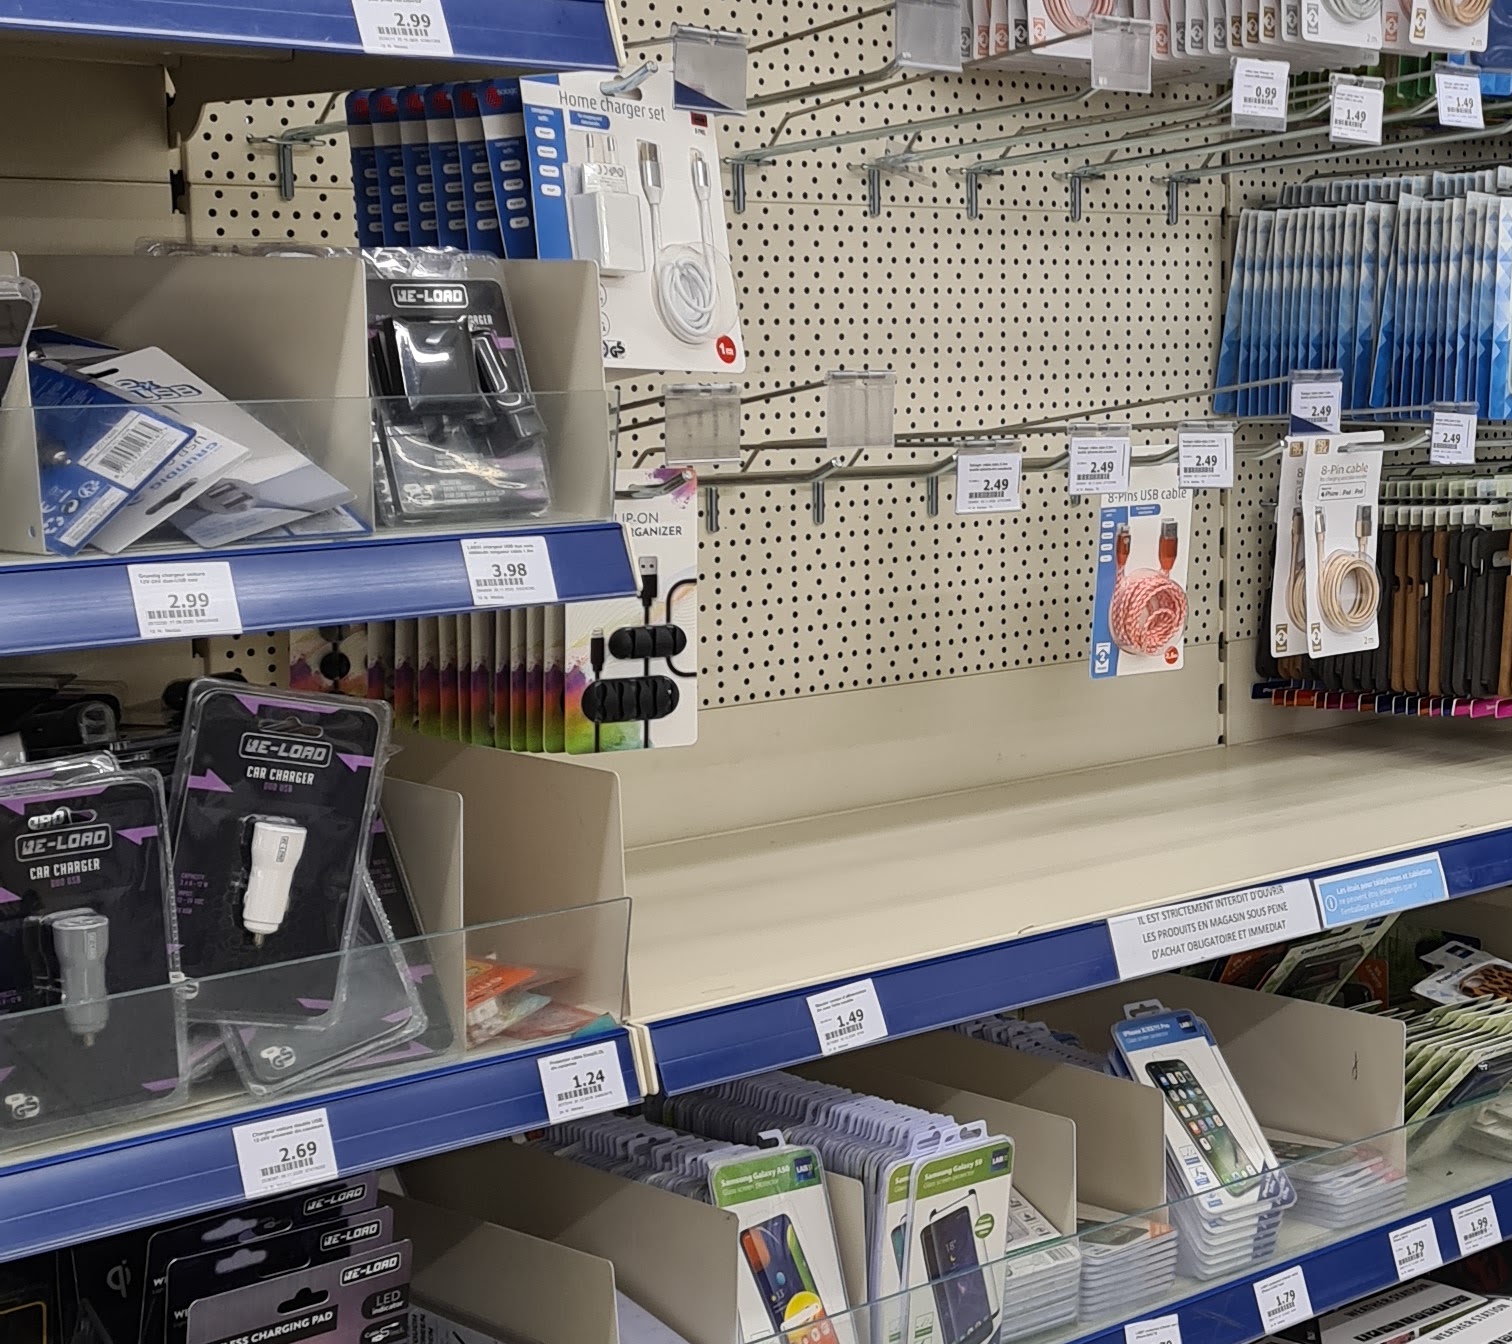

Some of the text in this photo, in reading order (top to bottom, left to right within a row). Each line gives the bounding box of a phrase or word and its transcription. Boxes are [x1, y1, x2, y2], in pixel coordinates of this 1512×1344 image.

[394, 12, 431, 28] 2.99
[1255, 86, 1277, 99] 0.99
[558, 90, 667, 123] Home charger set
[1456, 97, 1474, 110] 1.49
[1346, 109, 1367, 123] 1.49
[1312, 405, 1332, 417] 2.49
[1443, 432, 1461, 444] 2.49
[1091, 460, 1114, 473] 2.49
[1196, 454, 1218, 467] 2.49
[1320, 462, 1369, 476] 8-Pin cable
[983, 478, 1009, 491] 2.49
[1107, 486, 1187, 504] 8-Pins USB cable
[491, 563, 527, 577] 3.98
[167, 593, 210, 609] 2.99
[246, 766, 315, 786] CAR CHARGER
[29, 858, 101, 880] CAR CHARGER
[1137, 885, 1286, 926] IL EST STRICTEMENT INTERDIT D'OUVRIR
[1143, 901, 1289, 943] LES PRODUITS EN MAGASIN SOUS PEINE
[1151, 943, 1186, 960] D'ACHAT
[1238, 928, 1248, 941] ET
[1248, 918, 1287, 938] IMMEDIAT
[836, 1008, 865, 1027] 1.49
[572, 1068, 606, 1088] 1.24
[278, 1141, 318, 1163] 2.69
[720, 1173, 753, 1189] Samsung
[924, 1167, 951, 1182] Samsung
[1470, 1215, 1488, 1232] 1.99
[1405, 1239, 1425, 1256] 1.79
[375, 1289, 402, 1307] LED
[1276, 1289, 1296, 1306] 1.79
[1342, 1281, 1430, 1320] WEATHER STATION
[372, 1299, 404, 1315] indicator
[306, 1311, 334, 1333] PAD
[1430, 1300, 1512, 1341] WEATHER STATION
